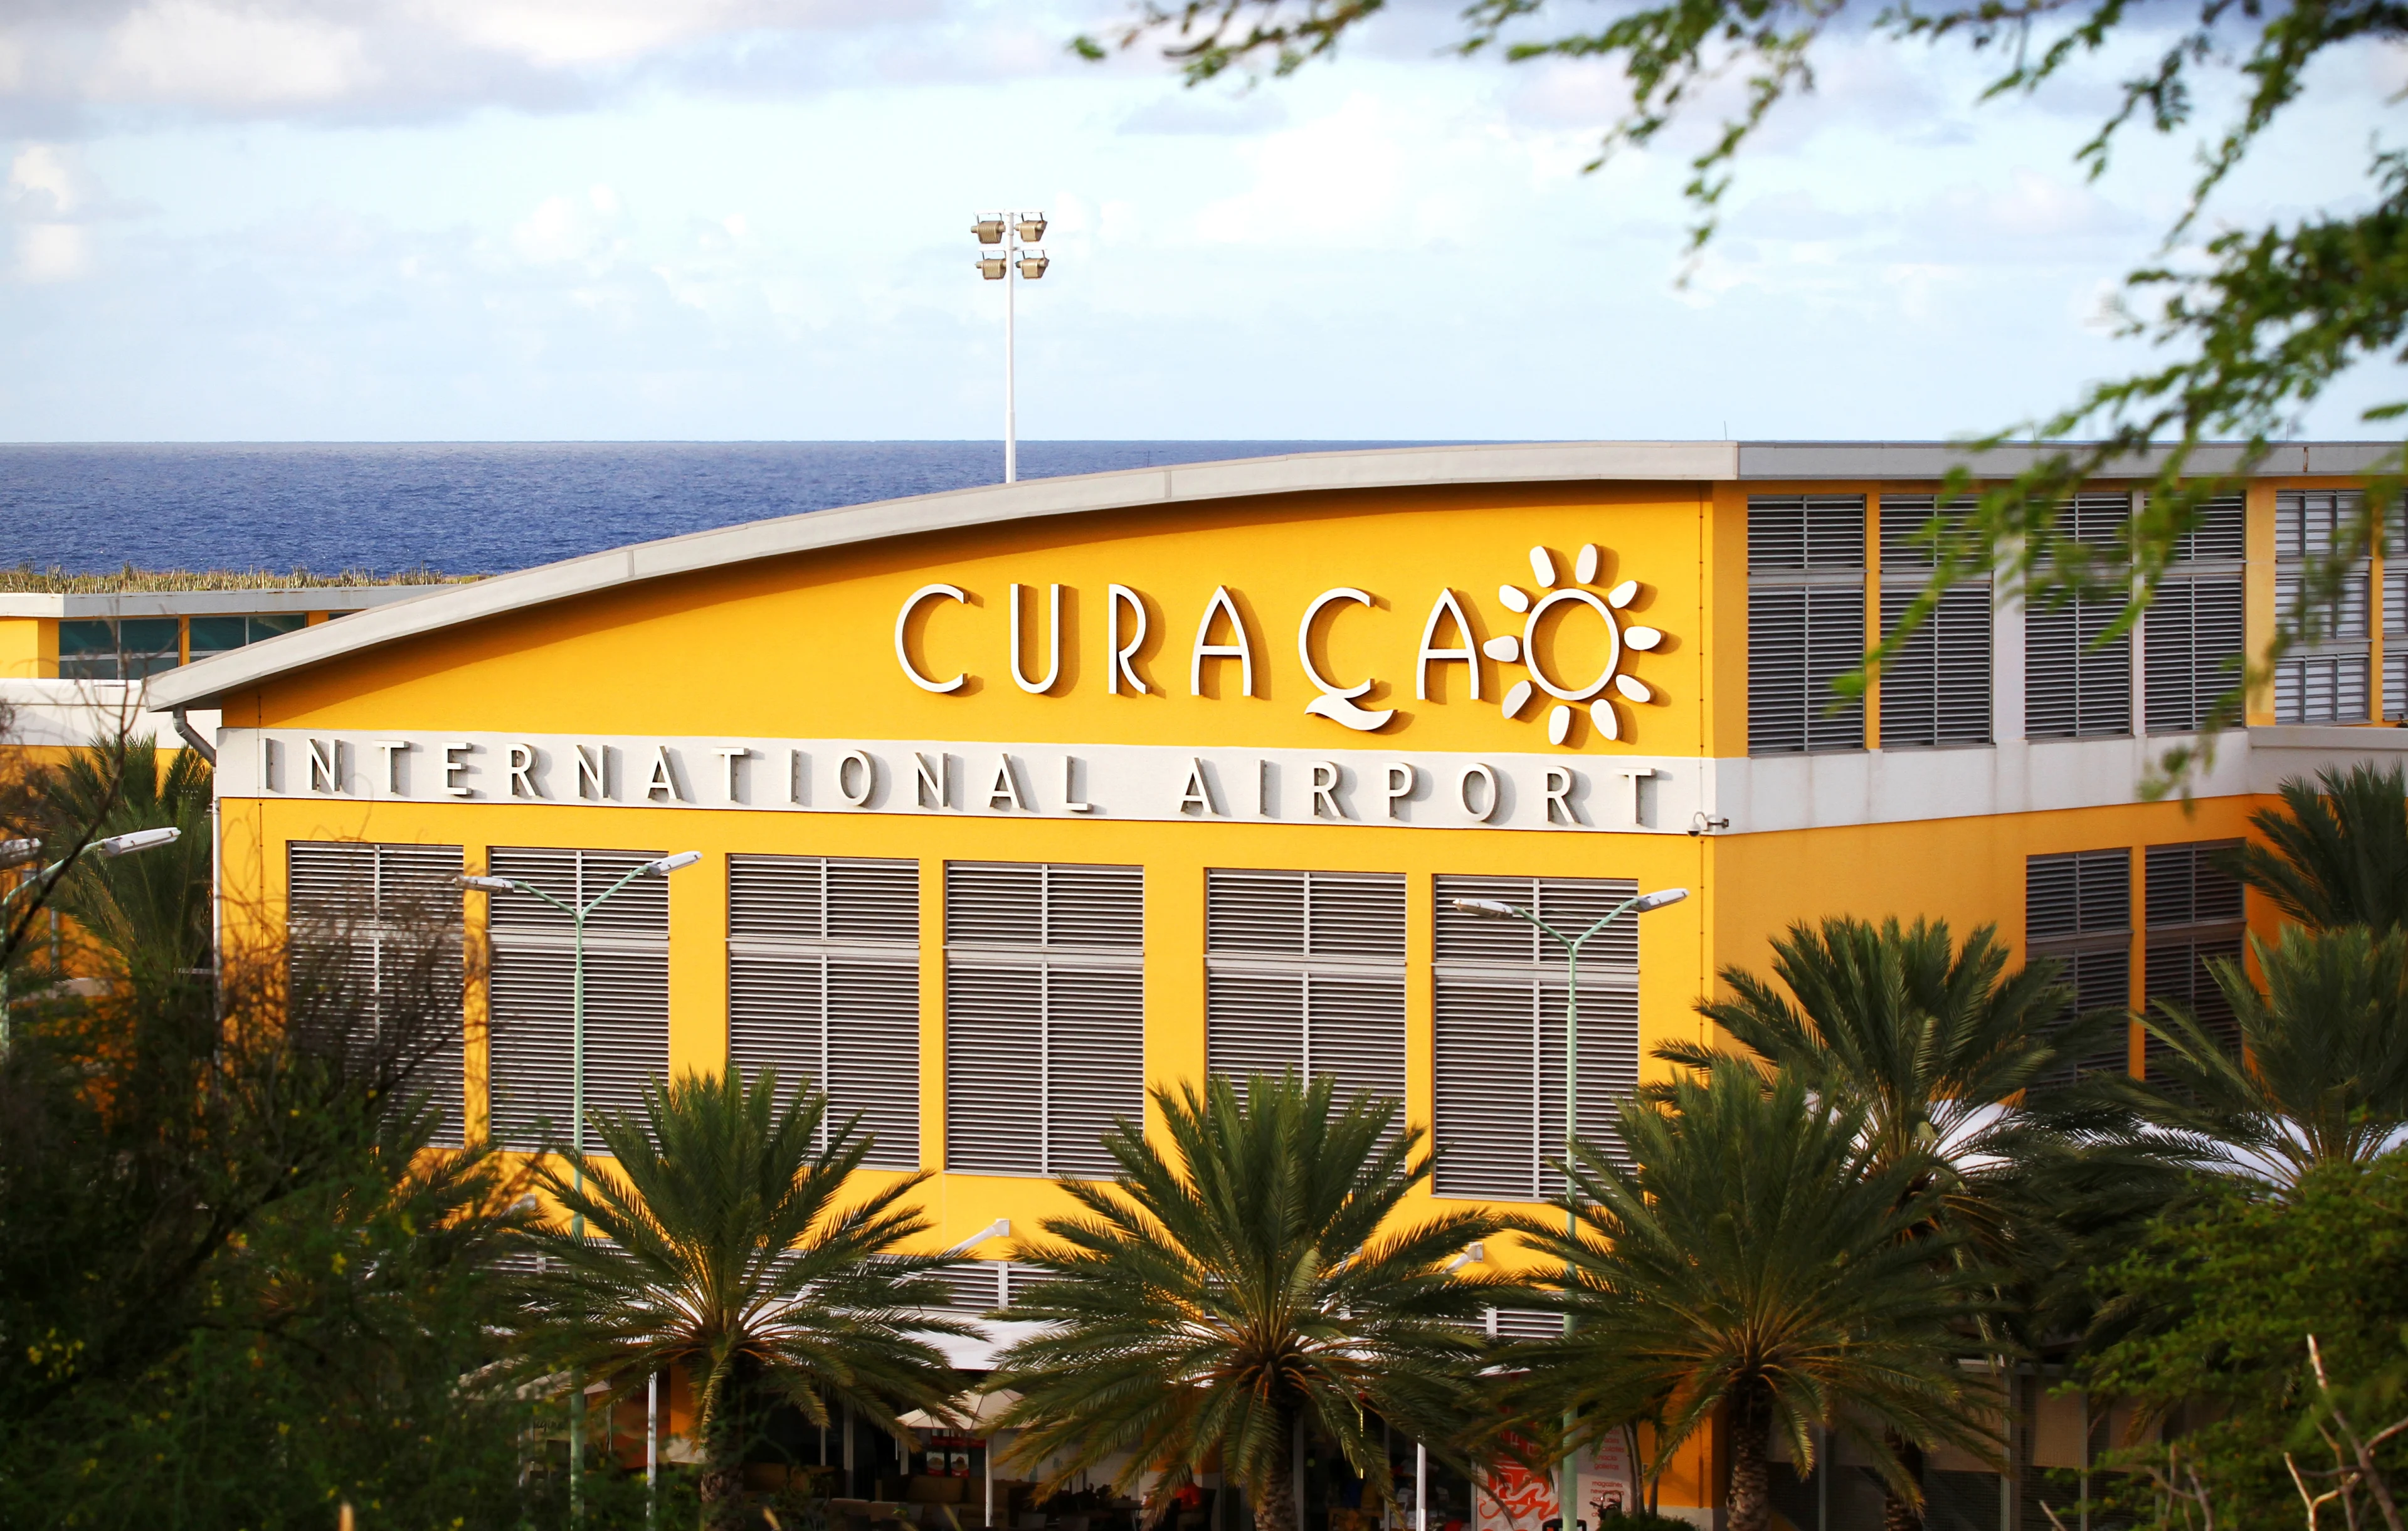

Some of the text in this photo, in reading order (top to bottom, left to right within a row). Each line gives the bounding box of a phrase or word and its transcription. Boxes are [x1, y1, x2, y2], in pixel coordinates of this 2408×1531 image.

[894, 582, 1622, 732] CURAÇAO
[261, 738, 1656, 825] INTERNATIONAL AIRPORT
